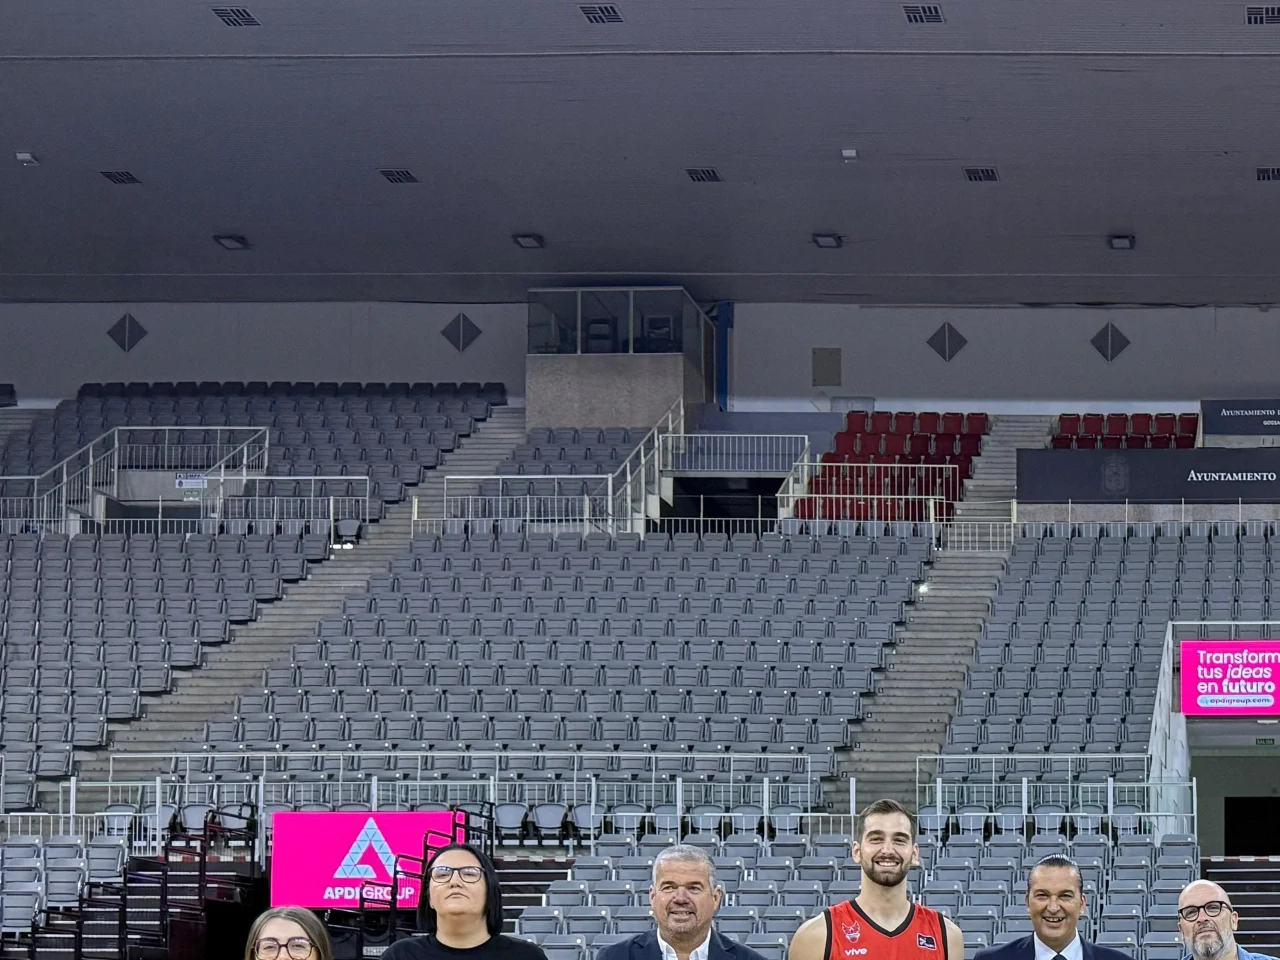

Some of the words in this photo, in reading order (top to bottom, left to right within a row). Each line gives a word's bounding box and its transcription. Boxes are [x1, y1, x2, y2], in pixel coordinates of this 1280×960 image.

[1197, 666, 1223, 679] tus
[1227, 665, 1272, 679] ideas
[1197, 682, 1219, 693] en
[1222, 679, 1276, 693] futuro
[845, 948, 868, 956] vive
